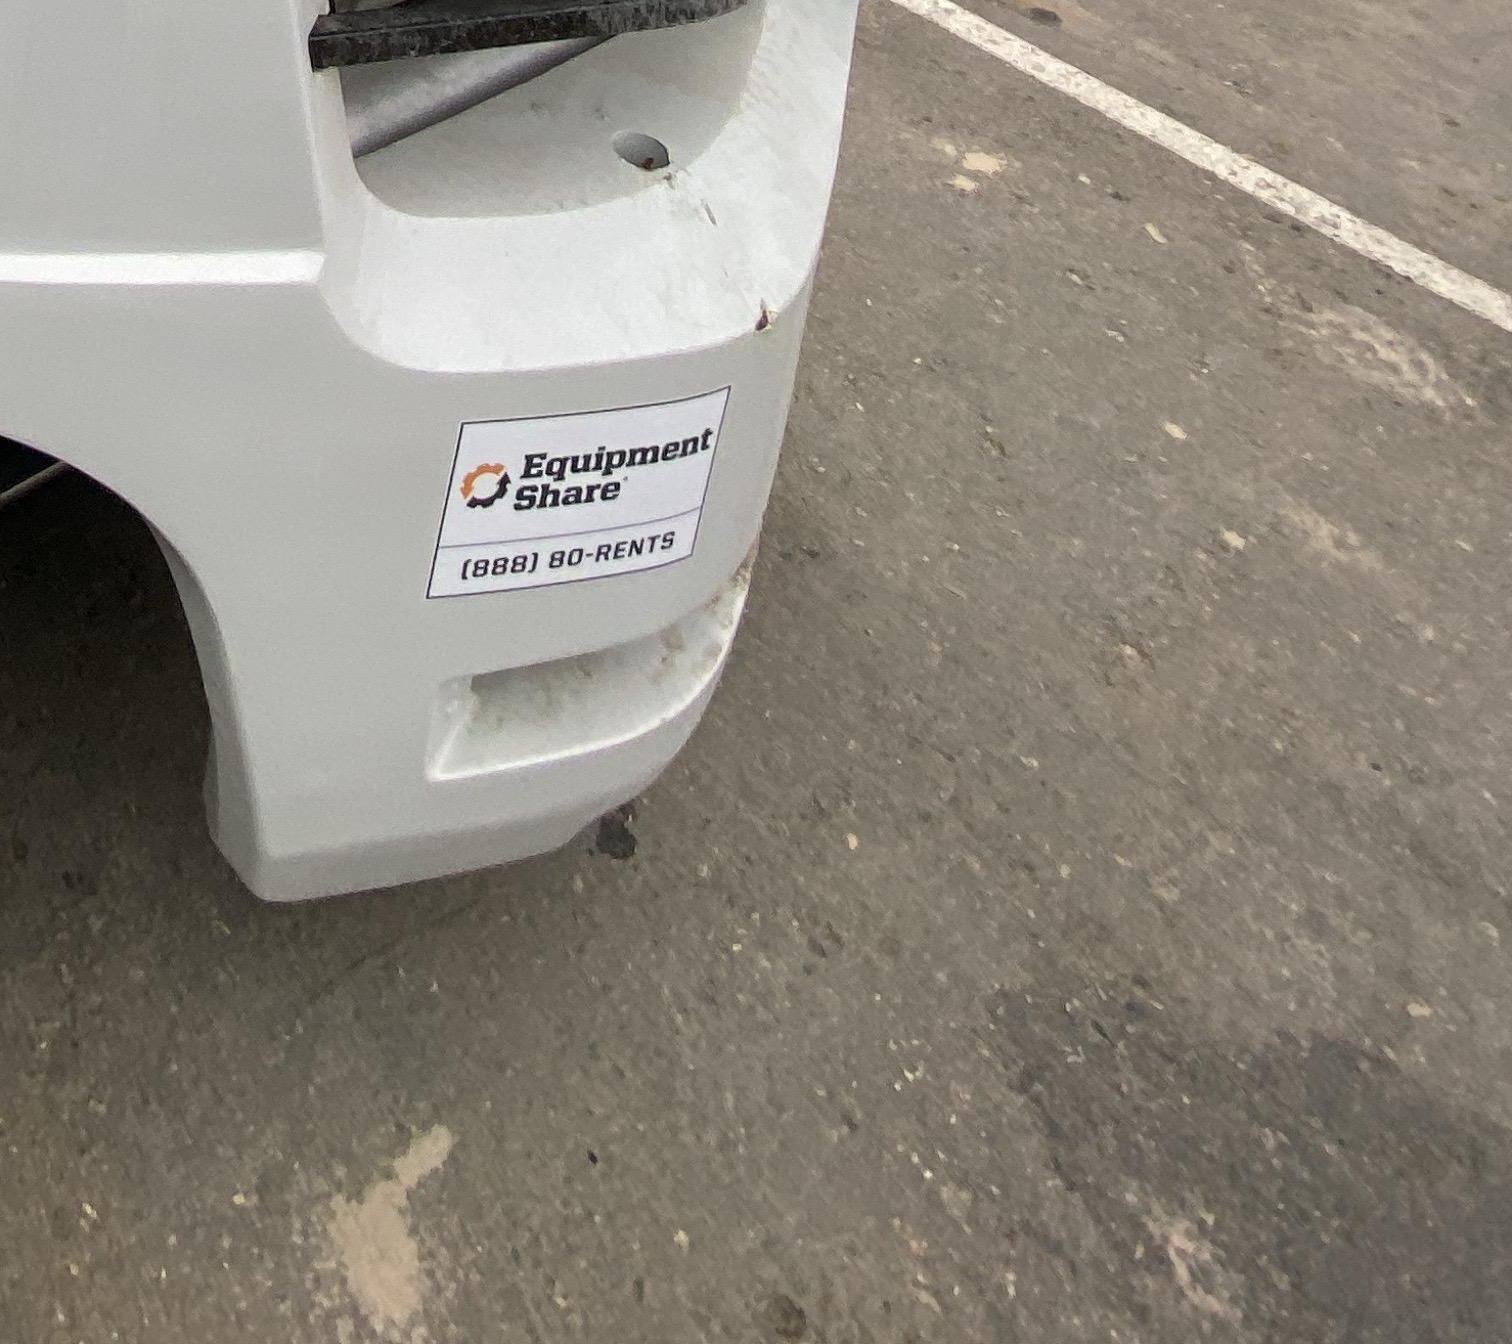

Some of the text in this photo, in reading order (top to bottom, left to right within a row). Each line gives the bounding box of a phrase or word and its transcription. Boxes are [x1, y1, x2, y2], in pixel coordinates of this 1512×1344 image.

[520, 427, 715, 482] Equipment
[513, 480, 622, 512] Share
[461, 530, 676, 581] (888) 80-RENTS
